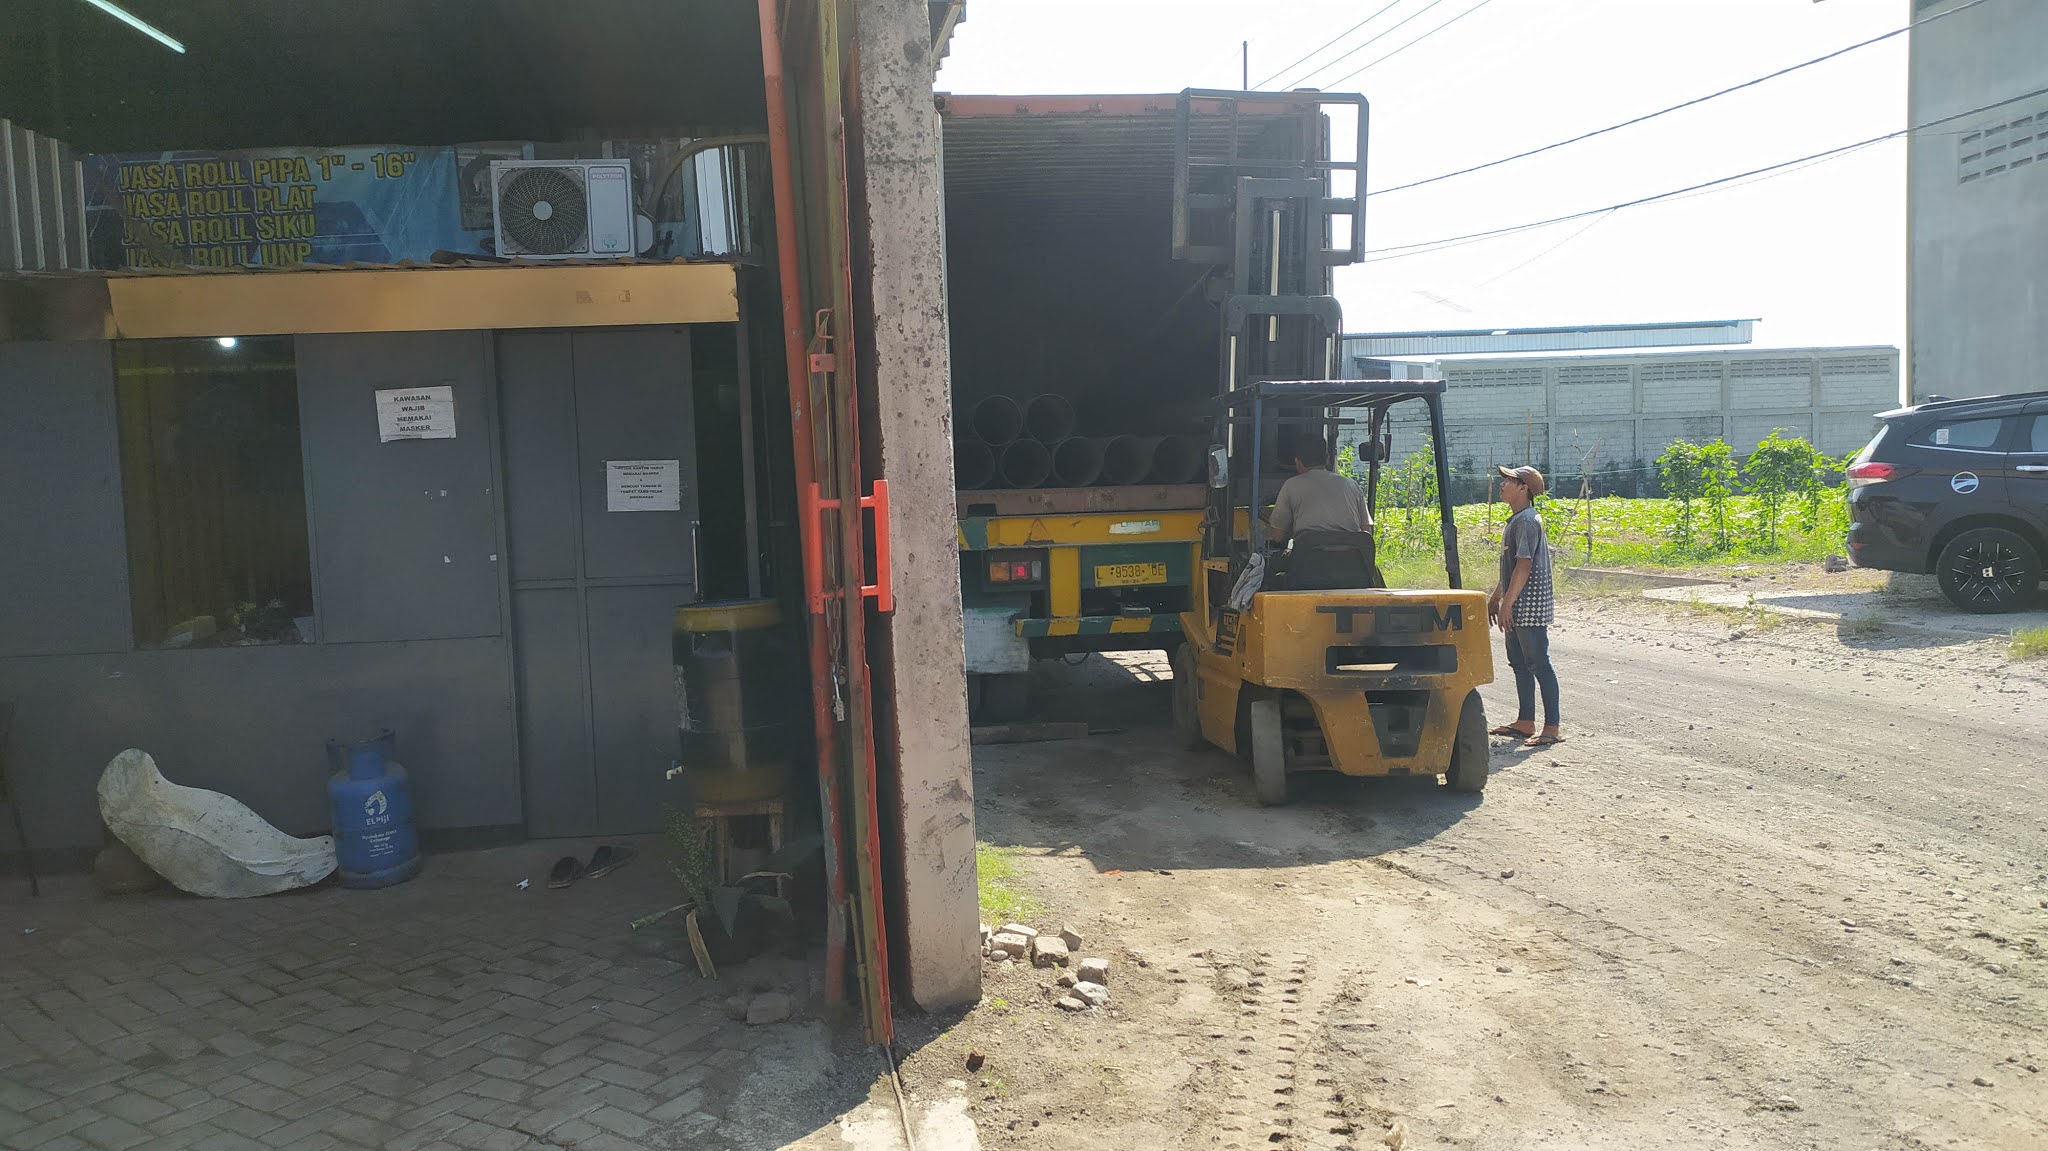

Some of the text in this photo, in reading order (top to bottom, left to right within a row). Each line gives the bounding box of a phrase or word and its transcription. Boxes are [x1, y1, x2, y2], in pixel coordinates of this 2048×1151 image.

[120, 163, 180, 190] JASA
[185, 160, 249, 187] ROLL
[253, 156, 311, 184] PIPA
[317, 154, 345, 181] 1"
[371, 152, 416, 179] 16"
[187, 189, 251, 216] ROLL
[256, 185, 318, 212] PLAT
[124, 214, 316, 245] JSA ROLL SIKU
[393, 394, 431, 402] KAWASAN
[1116, 565, 1141, 578] 9538
